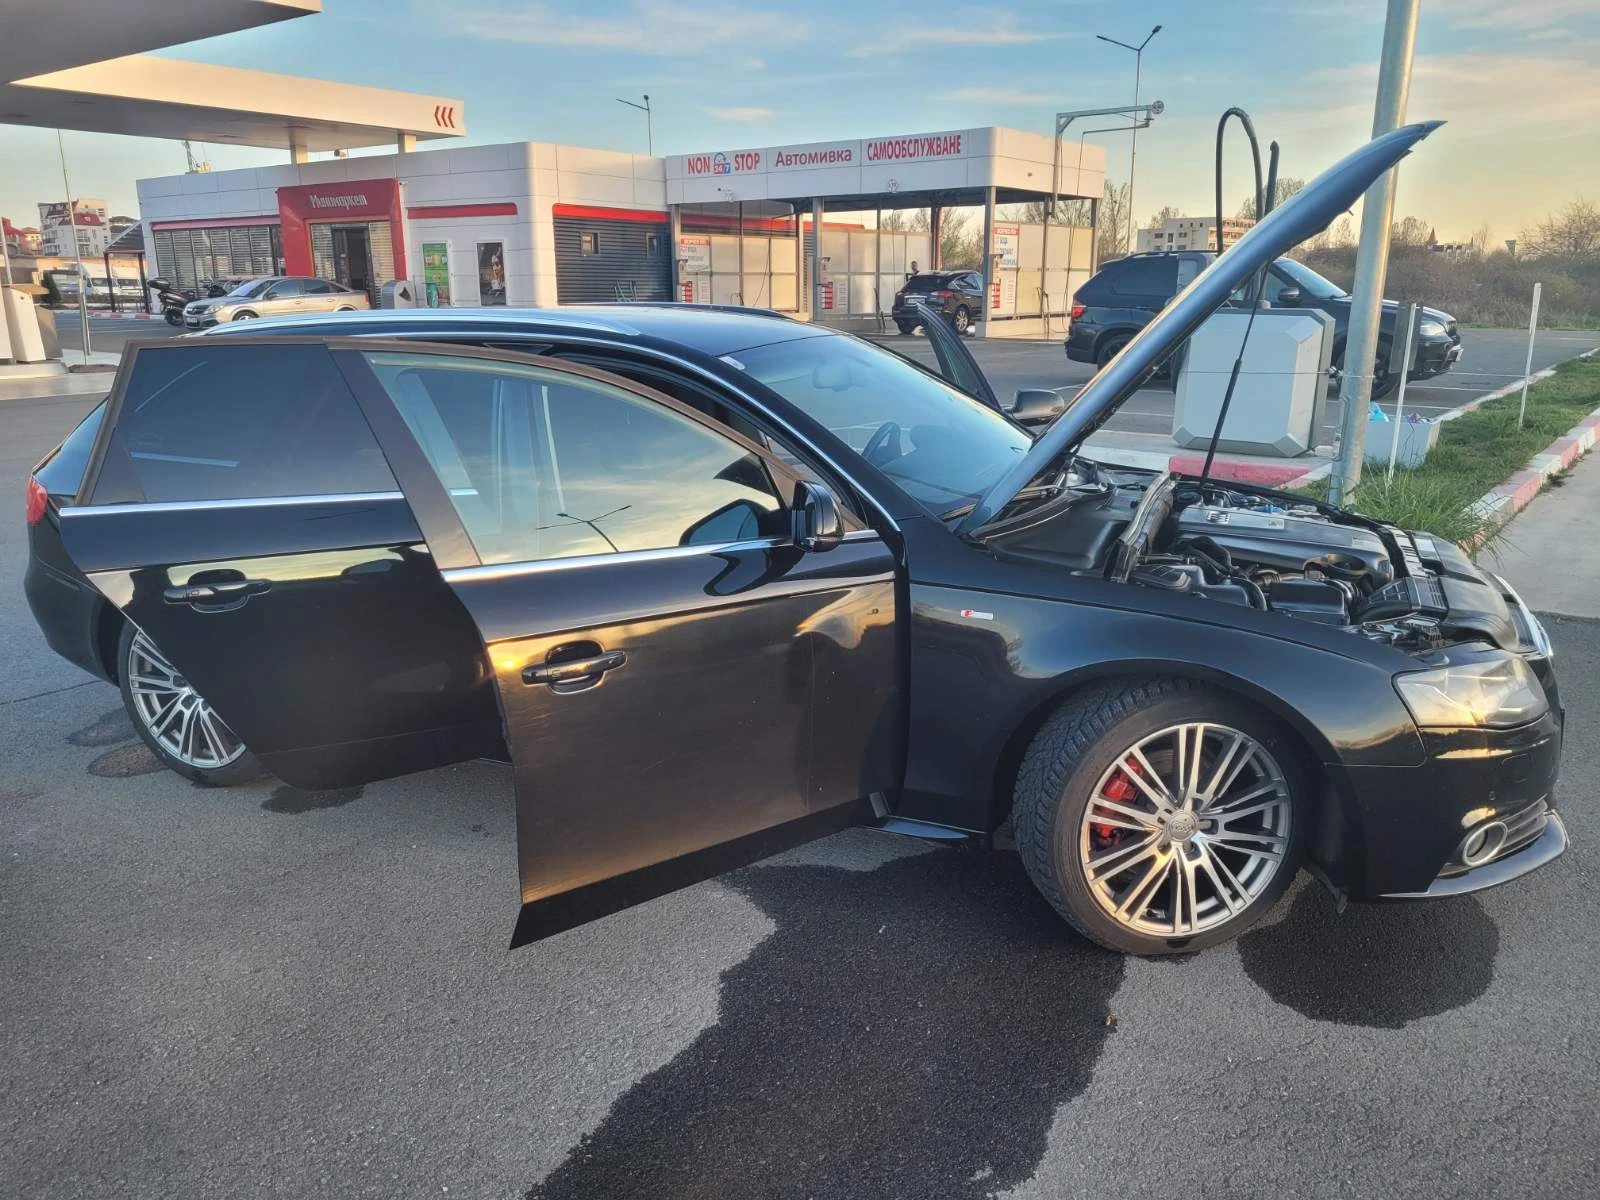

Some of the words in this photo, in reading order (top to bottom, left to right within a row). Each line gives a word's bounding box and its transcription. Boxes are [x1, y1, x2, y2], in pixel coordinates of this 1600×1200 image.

[775, 149, 852, 167] Автомивка
[867, 135, 961, 161] САМООБСЛУЖВАНЕ
[687, 156, 711, 174] NON
[734, 153, 760, 171] STOP
